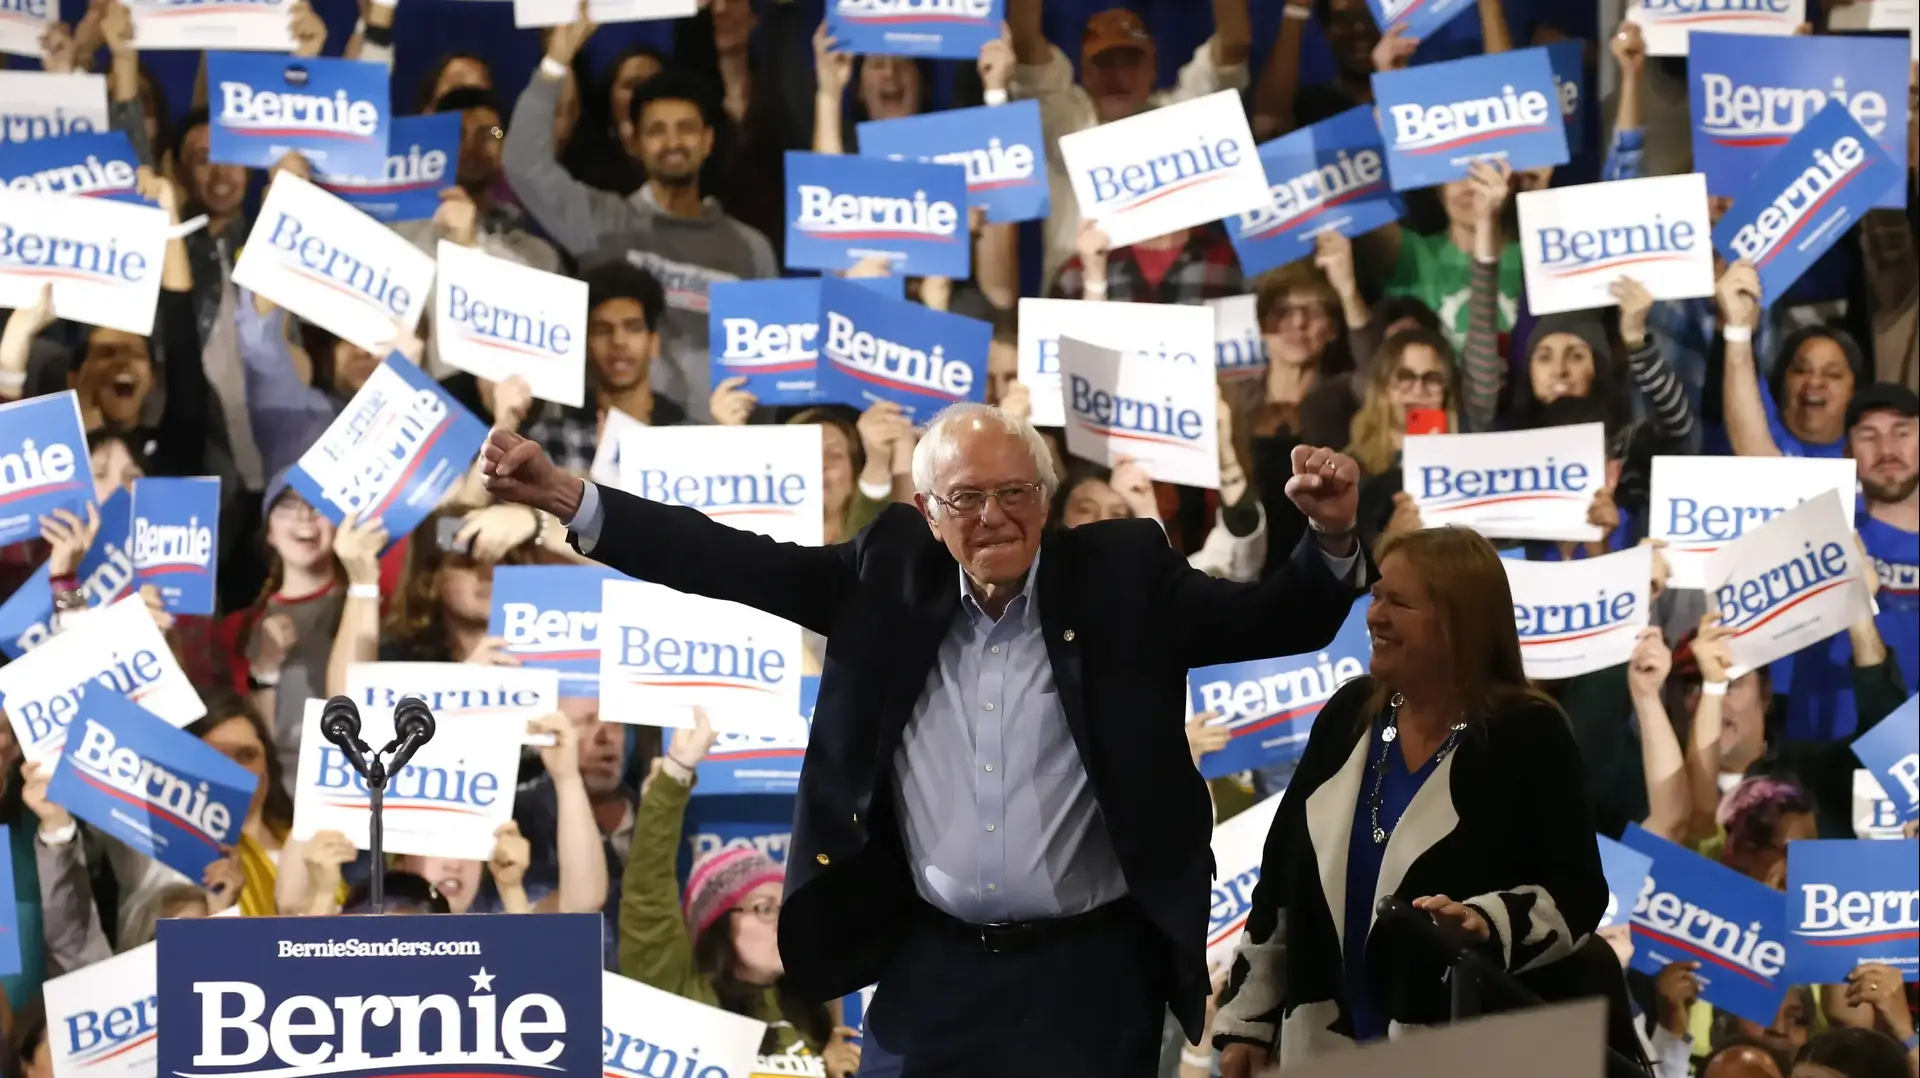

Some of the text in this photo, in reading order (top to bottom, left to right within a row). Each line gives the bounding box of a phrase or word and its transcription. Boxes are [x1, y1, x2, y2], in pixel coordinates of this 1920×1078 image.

[220, 81, 379, 137] Bernie
[1389, 84, 1549, 148] Bernie
[0, 153, 136, 197] ernie
[385, 143, 448, 183] nie
[1087, 131, 1242, 203] Bernie
[797, 185, 958, 237] Bernie
[1730, 135, 1865, 260] Bernie
[267, 211, 412, 316] Bernie
[1537, 213, 1695, 264] Bernie
[448, 283, 572, 355] Bernie
[722, 316, 820, 361] Ber
[826, 310, 974, 397] Bernie
[1069, 372, 1203, 440] Bernie
[640, 462, 806, 507] Bernie
[1420, 456, 1589, 500] Bernie
[135, 516, 212, 566] Bernie
[1666, 496, 1790, 541] Ber
[1715, 539, 1849, 627] Bernie
[502, 602, 602, 648] Ber
[1514, 589, 1636, 636] ernie
[618, 624, 786, 685] Bernie
[1199, 651, 1364, 723] Bernie
[75, 718, 232, 841] Bernie
[278, 937, 481, 958] BernieSanders.com
[64, 995, 157, 1054] Ber
[193, 966, 567, 1068] Bernie
[601, 1023, 730, 1078] erni
